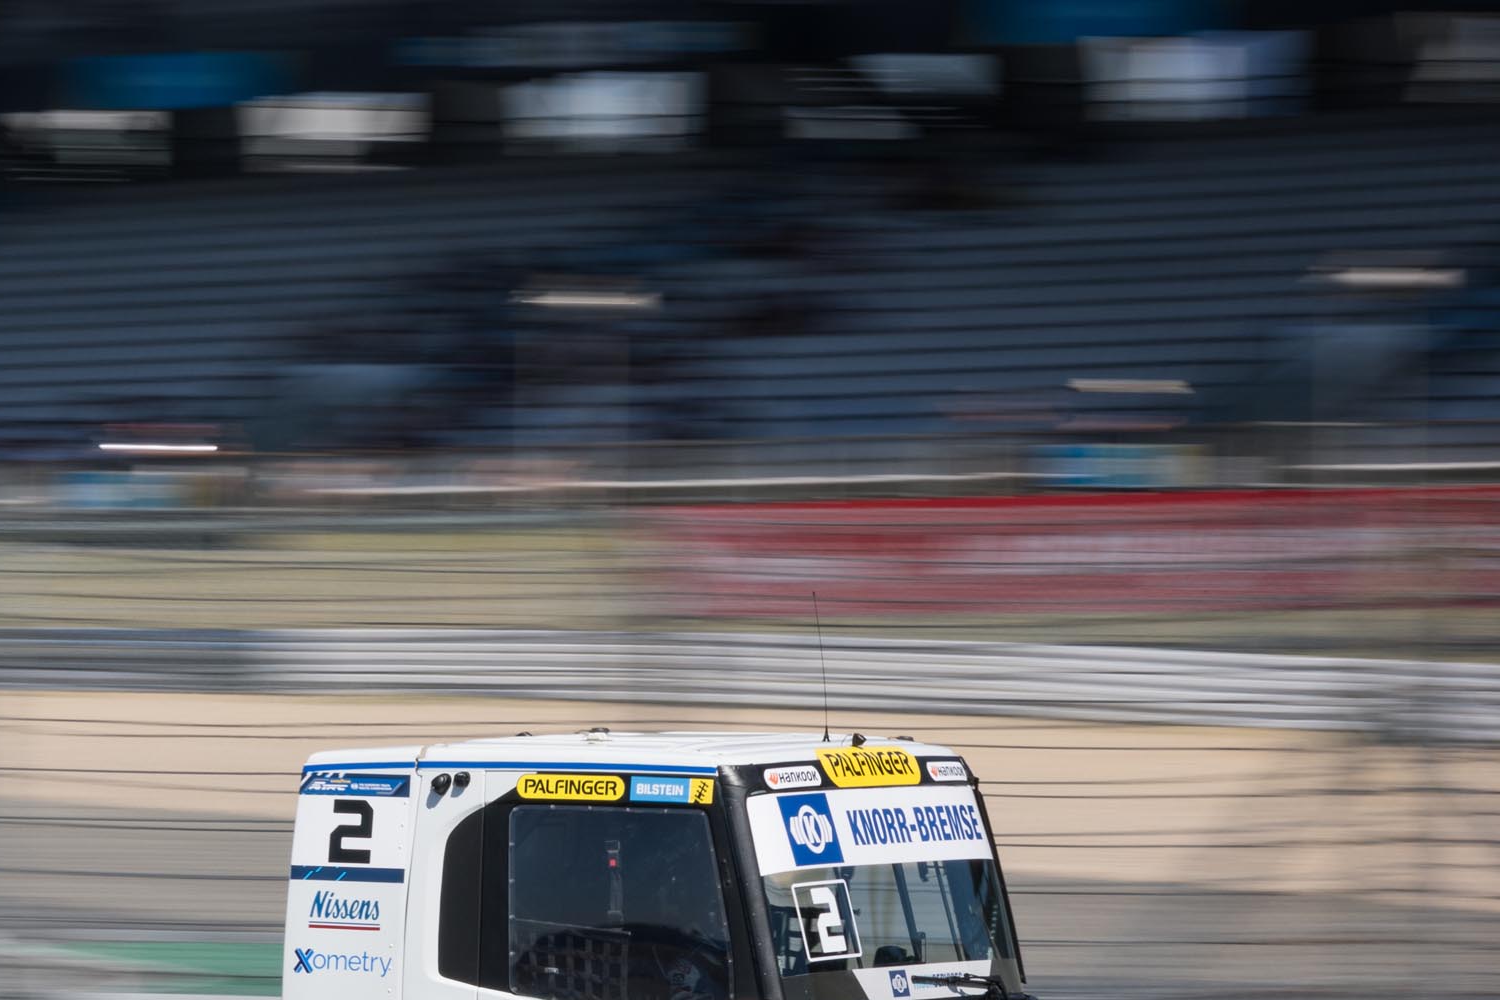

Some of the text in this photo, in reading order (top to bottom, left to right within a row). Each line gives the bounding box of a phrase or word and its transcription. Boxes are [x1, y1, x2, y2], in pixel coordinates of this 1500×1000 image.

[825, 751, 914, 778] PALFINGER
[524, 778, 617, 796] PALFINGER
[636, 783, 684, 796] BILSTEIN
[328, 799, 374, 864] 2
[846, 804, 983, 846] KNORR-BREMSE
[309, 890, 380, 920] Nissens
[809, 886, 848, 954] 2
[293, 947, 392, 977] Xometry
